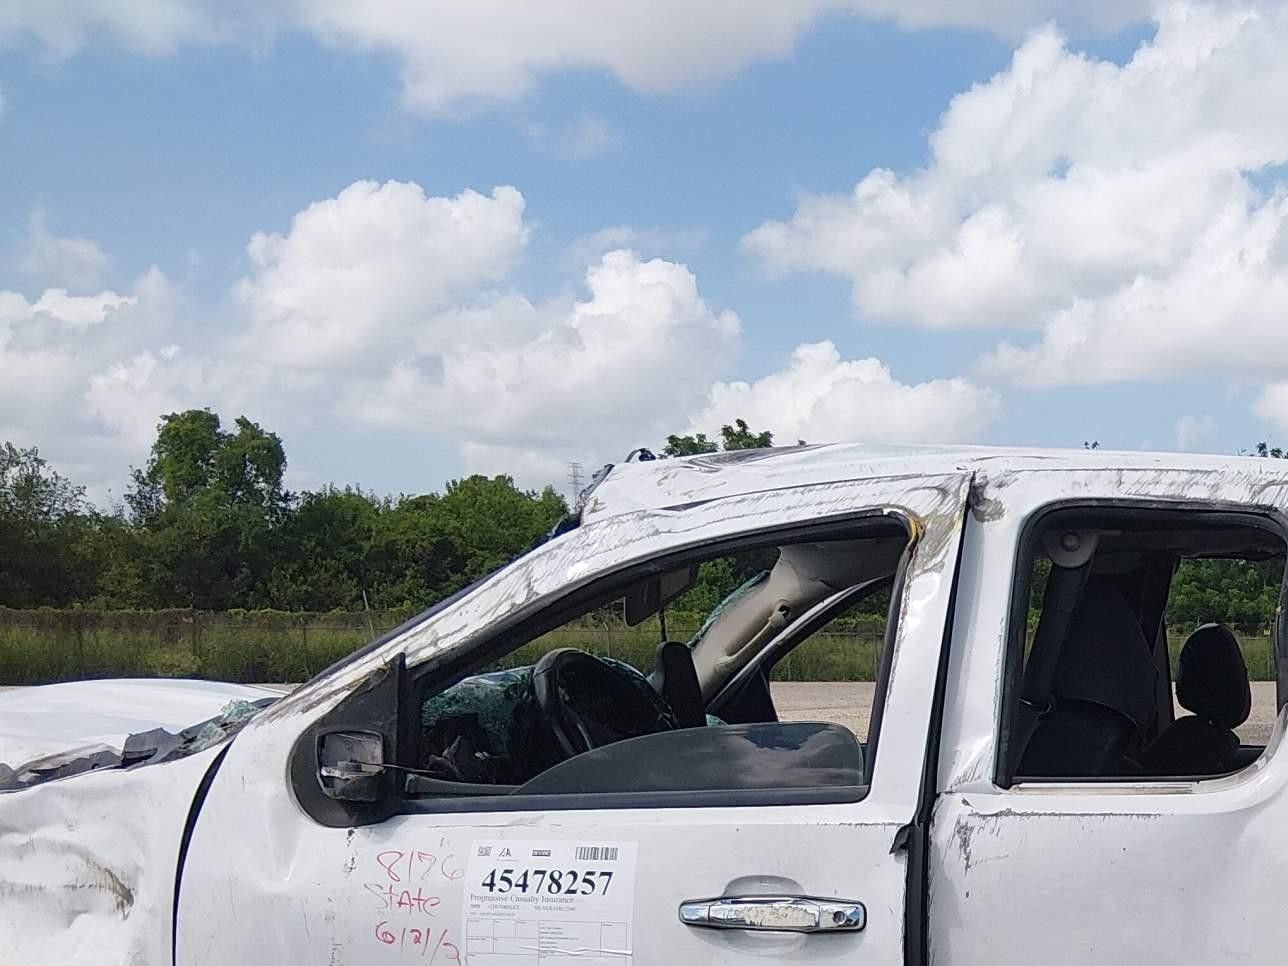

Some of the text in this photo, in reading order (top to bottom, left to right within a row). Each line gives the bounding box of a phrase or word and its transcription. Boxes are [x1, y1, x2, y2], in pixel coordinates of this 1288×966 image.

[481, 868, 614, 896] 45478257
[470, 893, 575, 904] Progressive Casualty Insurance
